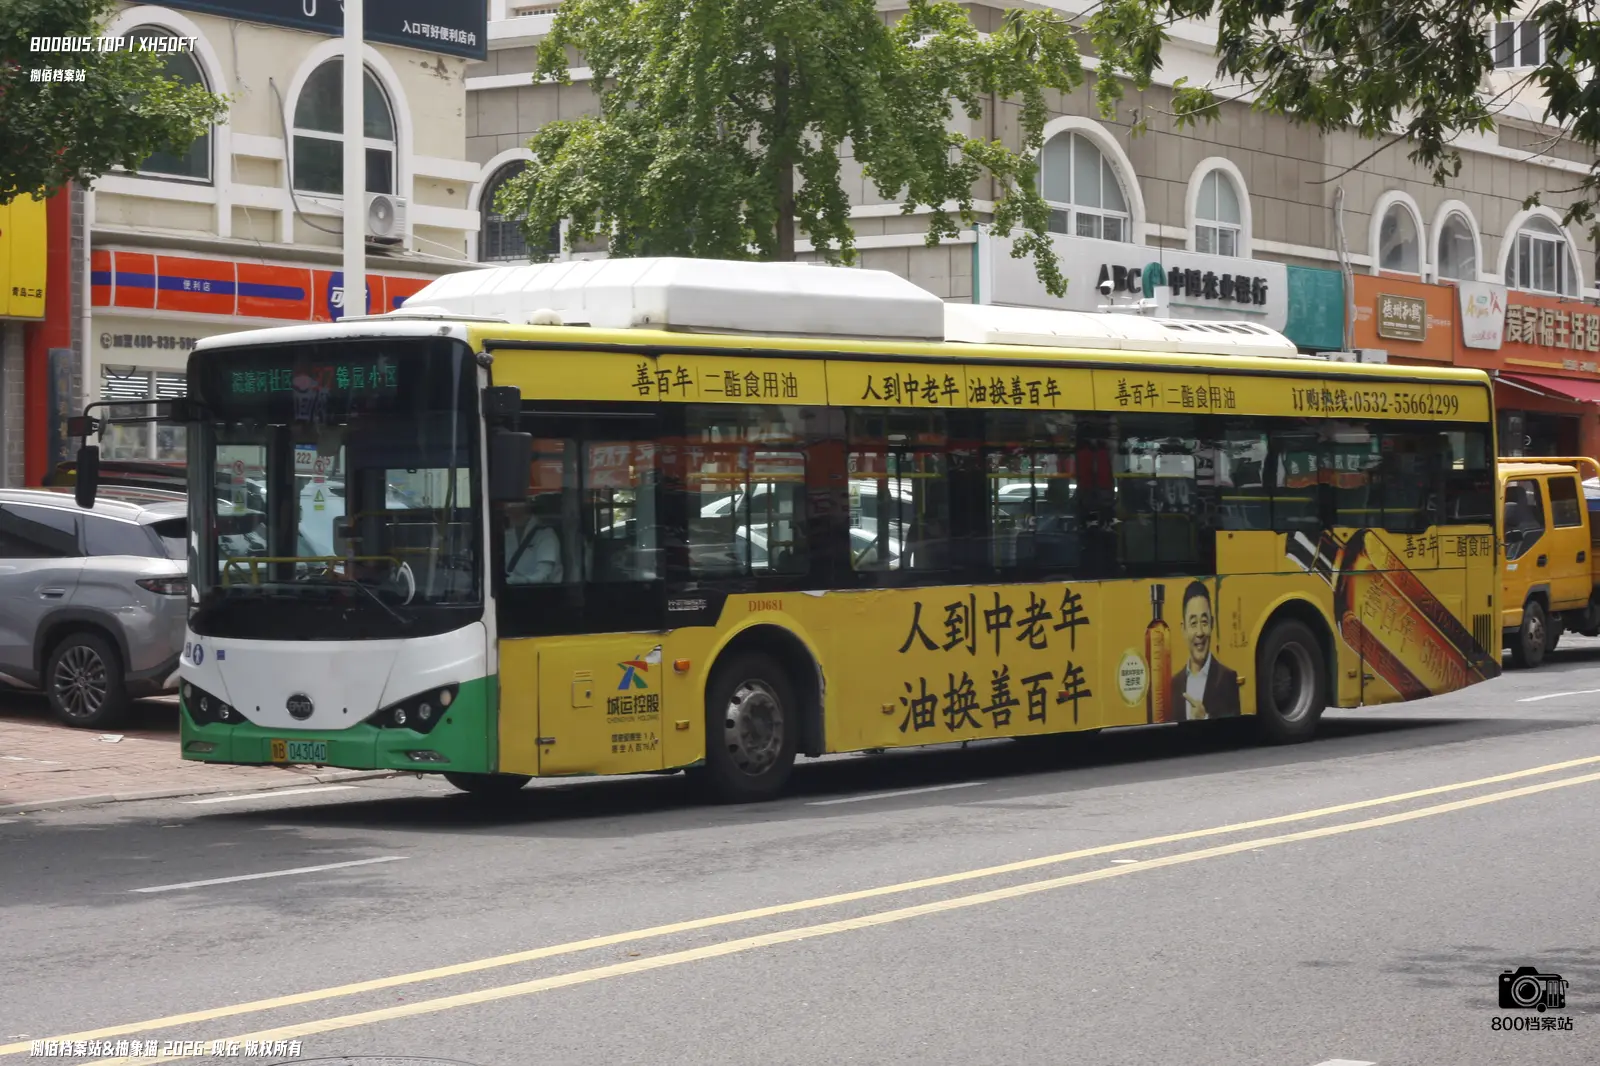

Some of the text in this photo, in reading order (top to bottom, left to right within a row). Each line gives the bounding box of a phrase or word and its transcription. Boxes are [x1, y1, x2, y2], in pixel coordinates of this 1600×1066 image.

[402, 20, 476, 46] 入口可好便利店内
[12, 286, 43, 299] 青岛二店
[183, 279, 212, 292] 便利店
[1096, 263, 1142, 294] ABC
[1168, 266, 1269, 306] 中国农业银行
[1506, 303, 1600, 352] 爱家福生活超
[632, 362, 799, 398] 善百年 二酯食用油
[861, 372, 1062, 408] 人到中老年 油换善百年
[1113, 378, 1237, 410] 善百年 二酯食用油
[1292, 387, 1460, 416] 订购热线:0532-55662299
[1403, 533, 1496, 560] 善百年 二酯食用
[748, 600, 783, 613] DD681
[897, 587, 1091, 657] 人到中老年
[606, 693, 660, 716] 城运控股
[897, 660, 1093, 734] 油换善百年
